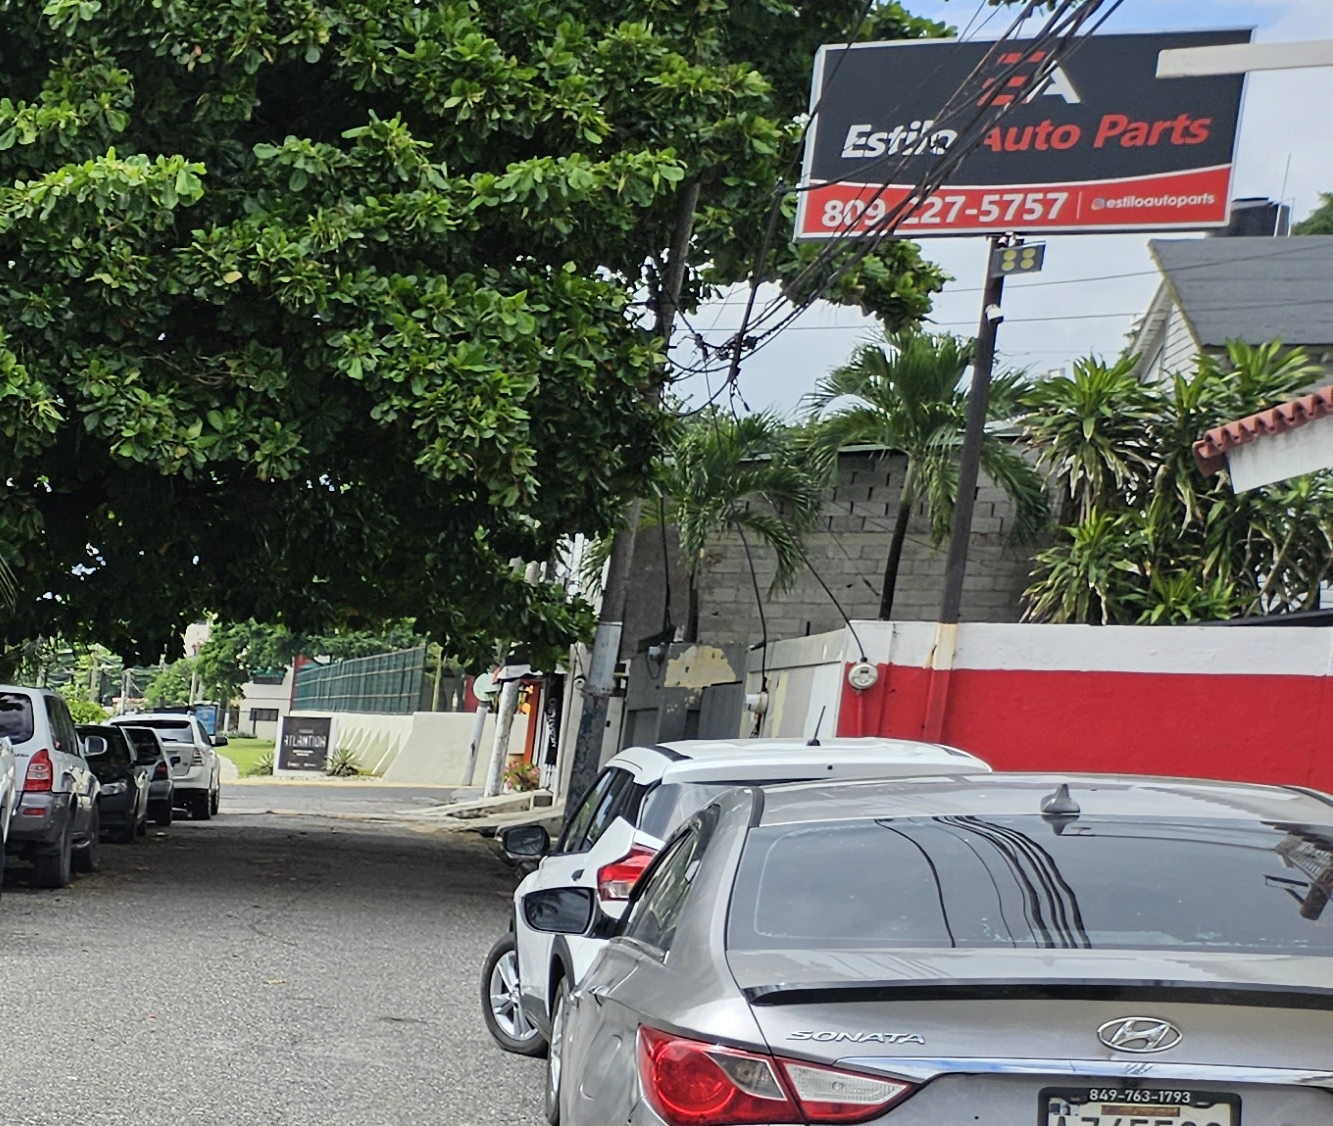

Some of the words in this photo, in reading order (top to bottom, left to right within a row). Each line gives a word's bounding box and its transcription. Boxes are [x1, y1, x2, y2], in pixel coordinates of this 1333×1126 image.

[841, 120, 958, 158] Estilo
[982, 118, 1081, 152] Auto
[1093, 113, 1213, 149] Parts
[821, 191, 1068, 228] 80927-5757
[786, 1030, 925, 1044] SONATA
[1089, 1089, 1191, 1103] 849-763-1793
